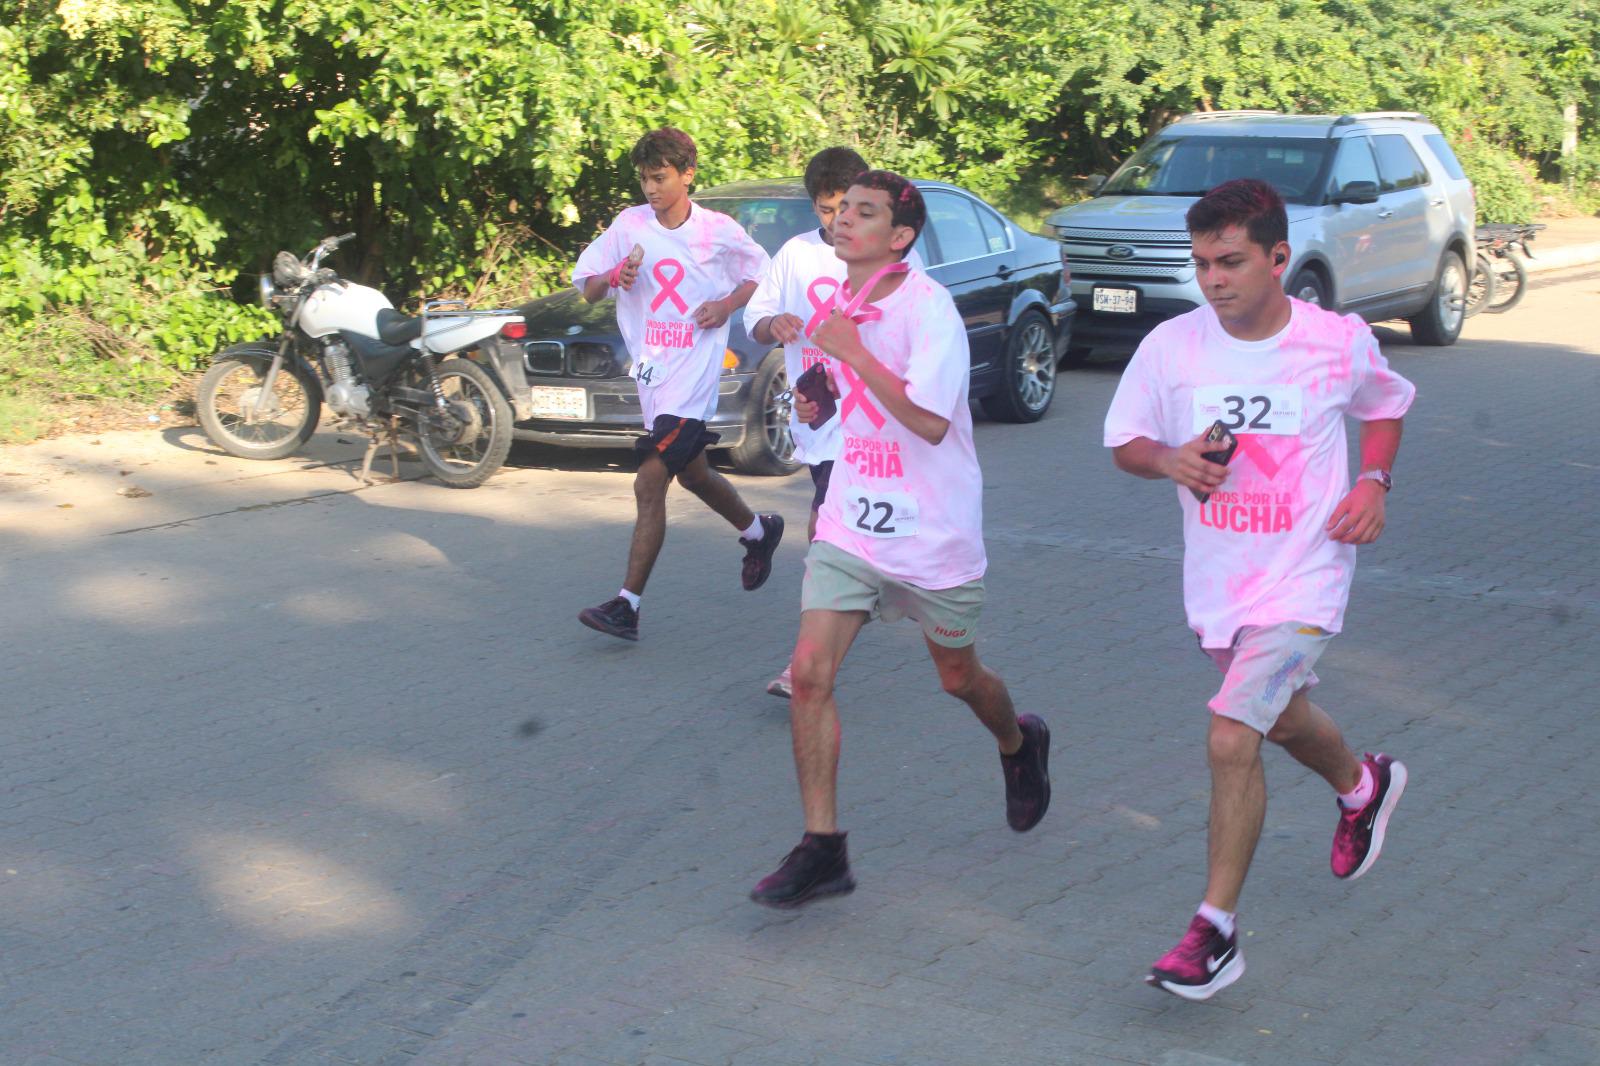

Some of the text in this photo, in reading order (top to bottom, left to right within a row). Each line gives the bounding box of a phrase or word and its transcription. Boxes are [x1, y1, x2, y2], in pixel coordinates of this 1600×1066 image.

[645, 327, 694, 349] LUCHA
[1223, 395, 1272, 430] 32
[862, 440, 882, 452] POR
[885, 441, 900, 453] LA
[1243, 493, 1270, 505] POR
[1275, 493, 1292, 505] LA
[856, 497, 896, 533] 22
[1200, 503, 1293, 533] LUCHA
[935, 626, 967, 638] HUGO
